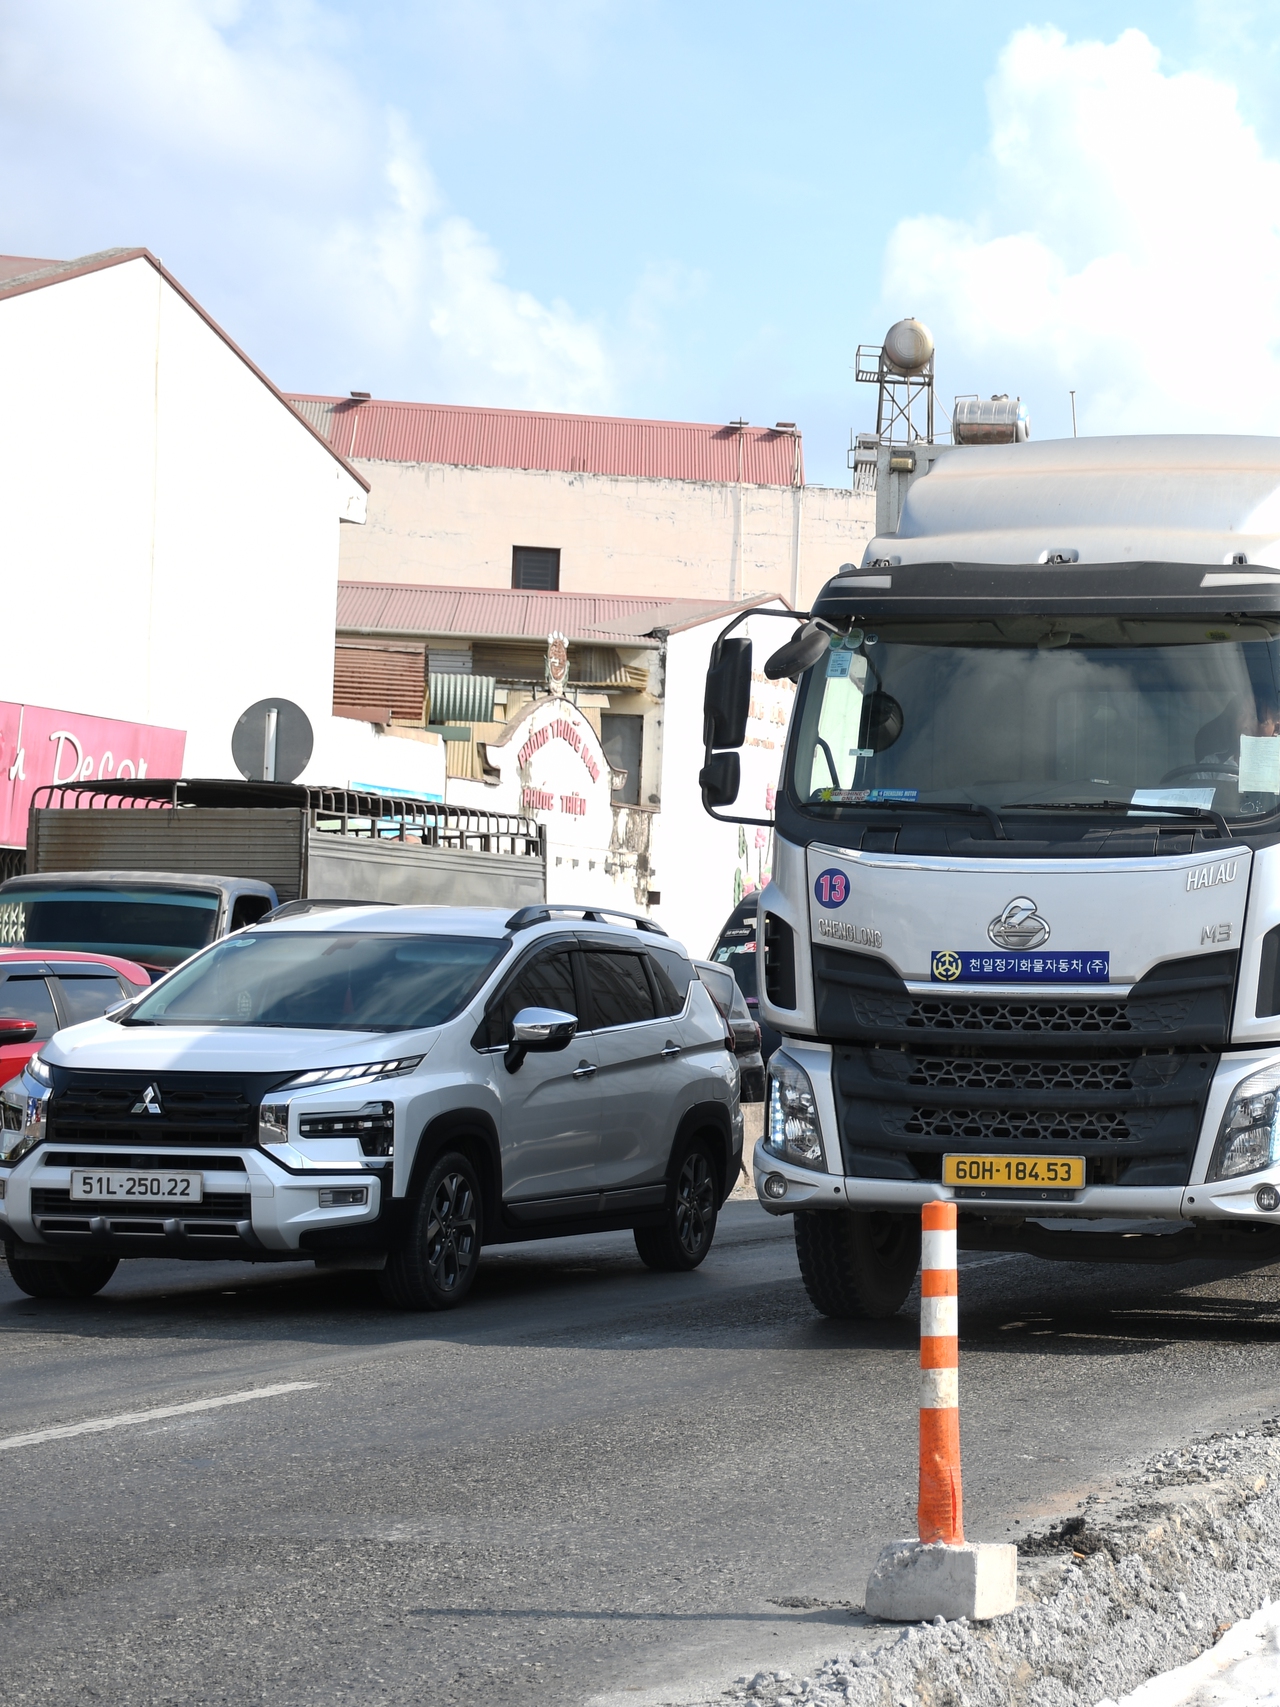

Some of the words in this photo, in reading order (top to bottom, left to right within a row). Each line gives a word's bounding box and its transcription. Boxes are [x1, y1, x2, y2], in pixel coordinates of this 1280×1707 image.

[50, 731, 148, 786] Decor
[581, 744, 600, 784] NAM
[820, 874, 846, 902] 13
[818, 918, 883, 949] CHENGLONG
[1200, 922, 1233, 946] M3
[969, 958, 1083, 974] 천일정기화물자동차
[1086, 959, 1109, 975] (주)
[955, 1160, 1072, 1182] 60H-184.53
[82, 1176, 191, 1196] 51L-250.22
